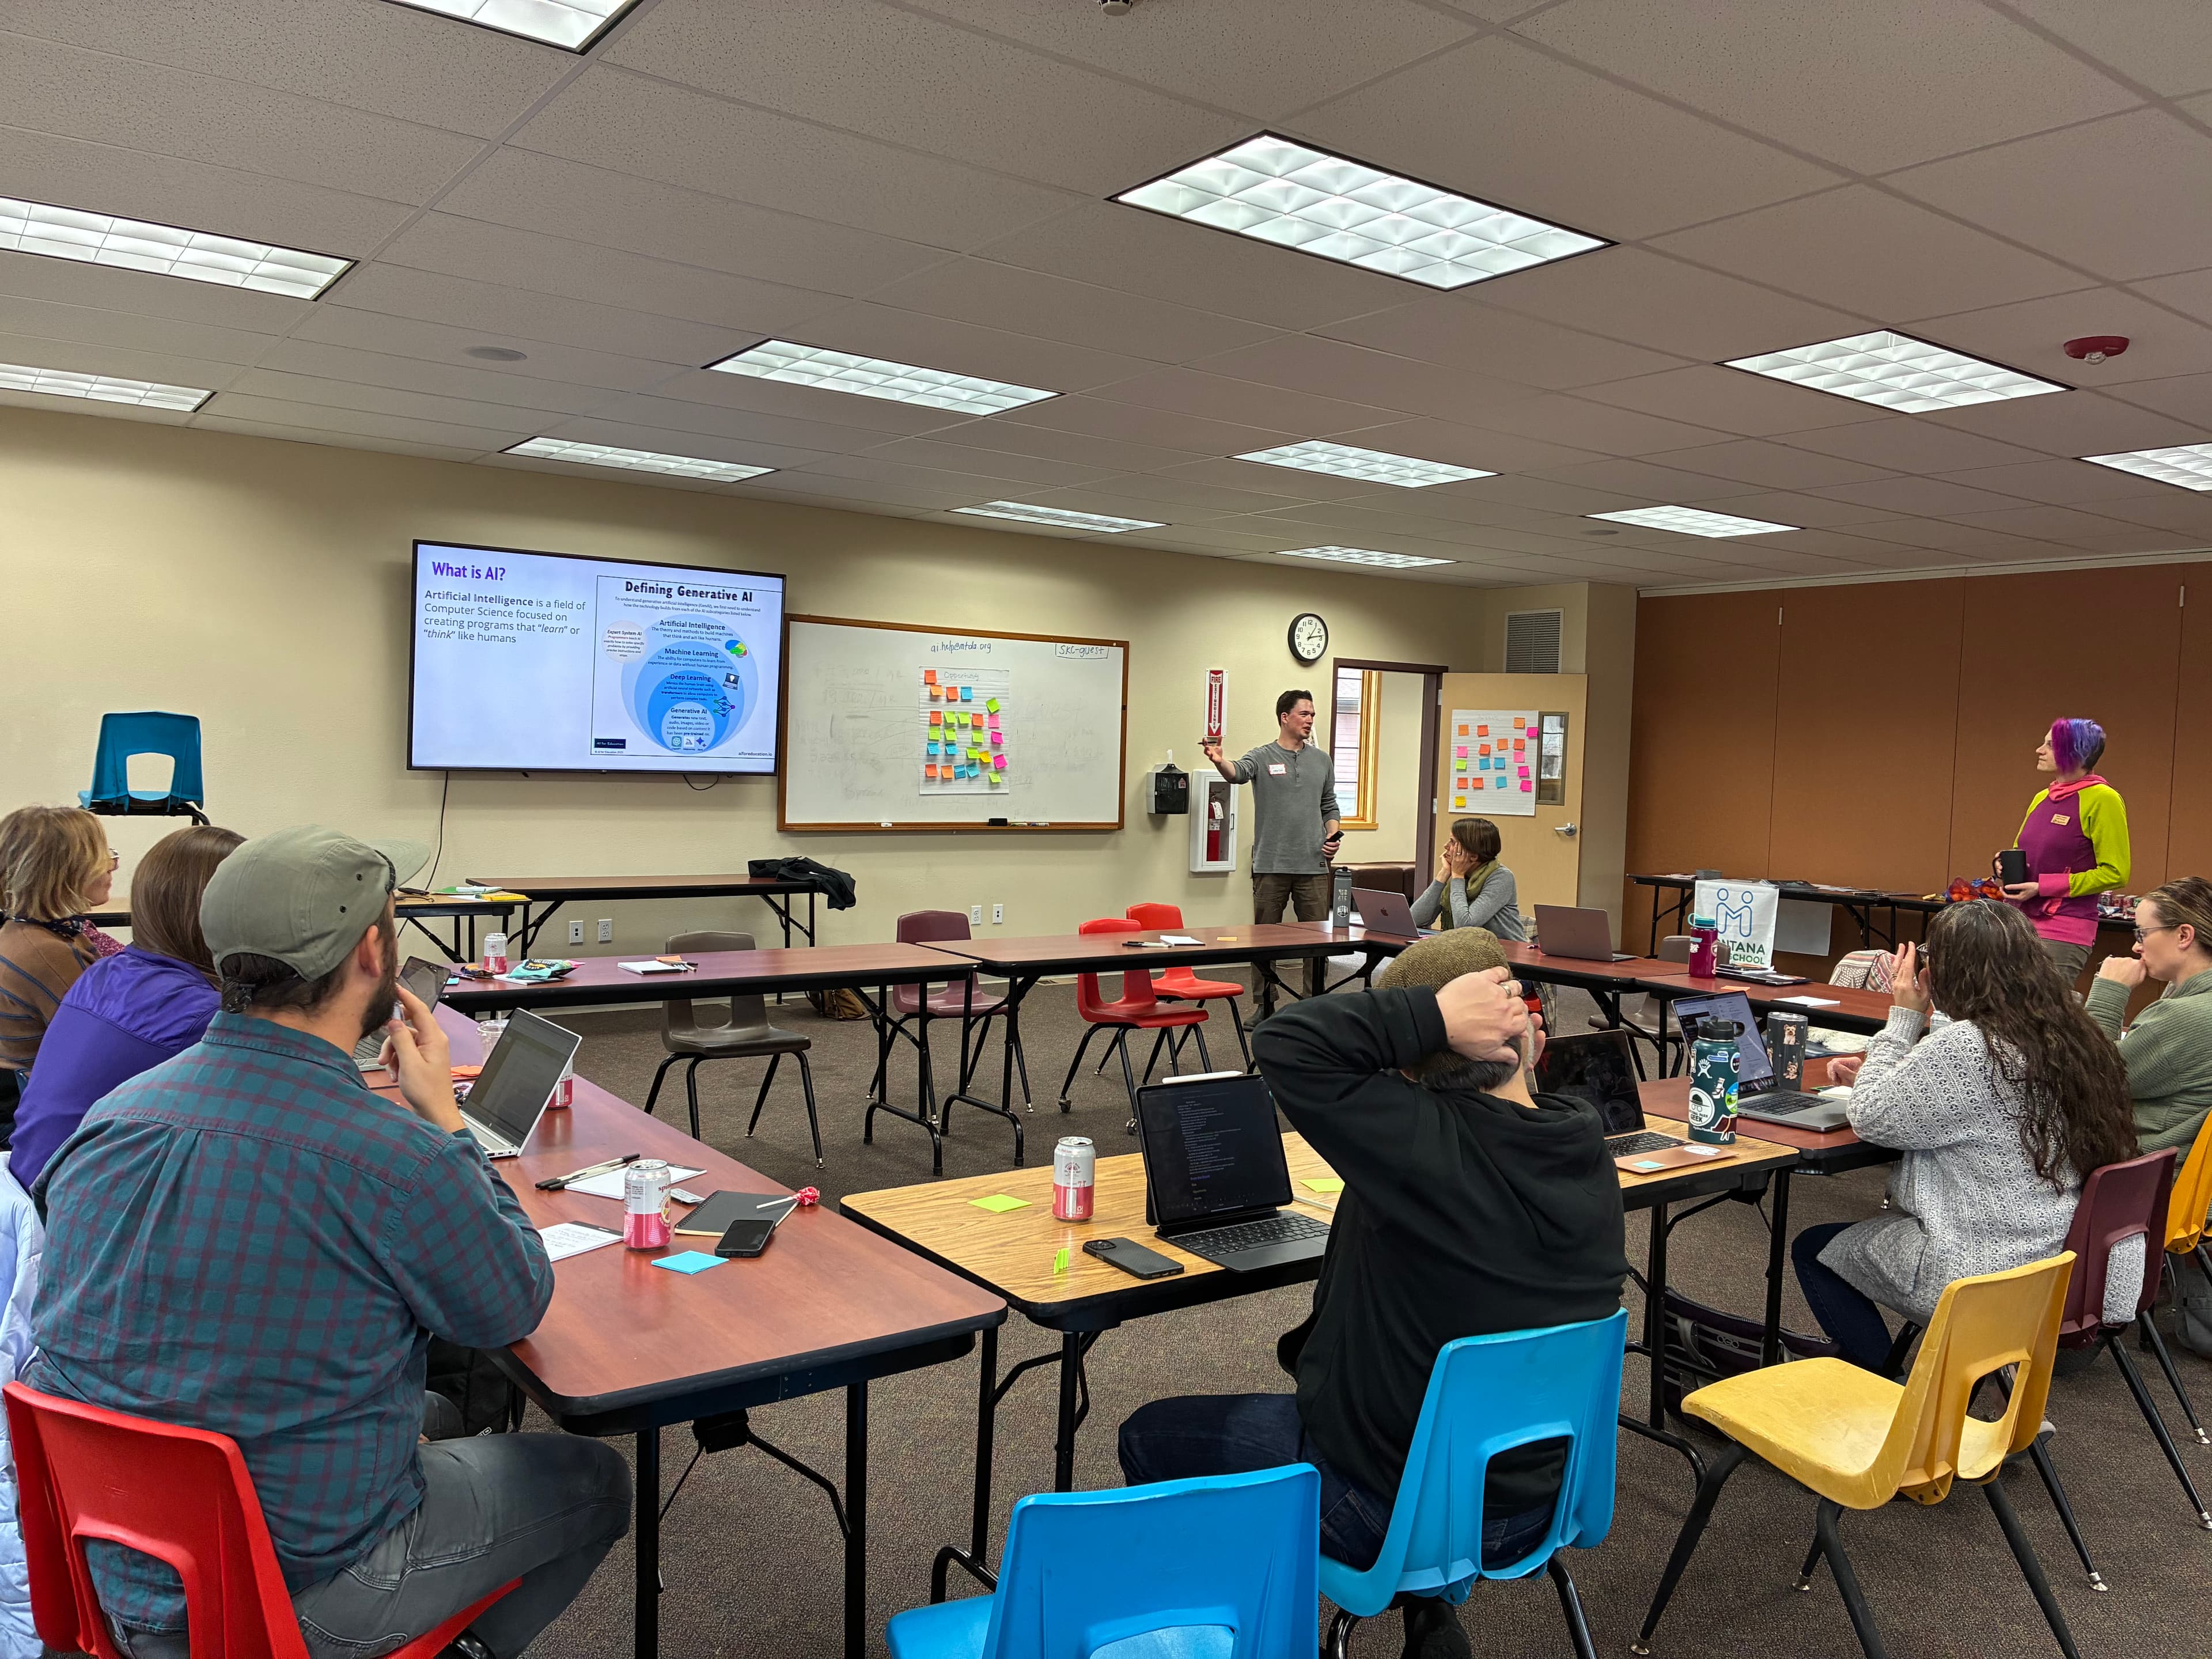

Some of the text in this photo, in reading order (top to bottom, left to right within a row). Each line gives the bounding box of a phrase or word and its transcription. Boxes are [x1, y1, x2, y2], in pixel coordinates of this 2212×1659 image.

[432, 561, 506, 581] What is AI?
[626, 581, 752, 602] Defining Generative AI
[425, 590, 471, 601] Artificial
[474, 594, 533, 607] Intelligence
[536, 599, 543, 607] is
[554, 600, 573, 609] field
[576, 602, 586, 610] of
[425, 603, 475, 615] Computer
[478, 607, 513, 618] Science
[516, 609, 552, 620] focused
[425, 618, 464, 629] creating
[467, 621, 514, 631] programs
[517, 623, 536, 632] that
[660, 620, 726, 631] Artificial Intelligence
[459, 631, 474, 640] like
[478, 632, 516, 643] humans
[1059, 645, 1105, 658] SKC-guest
